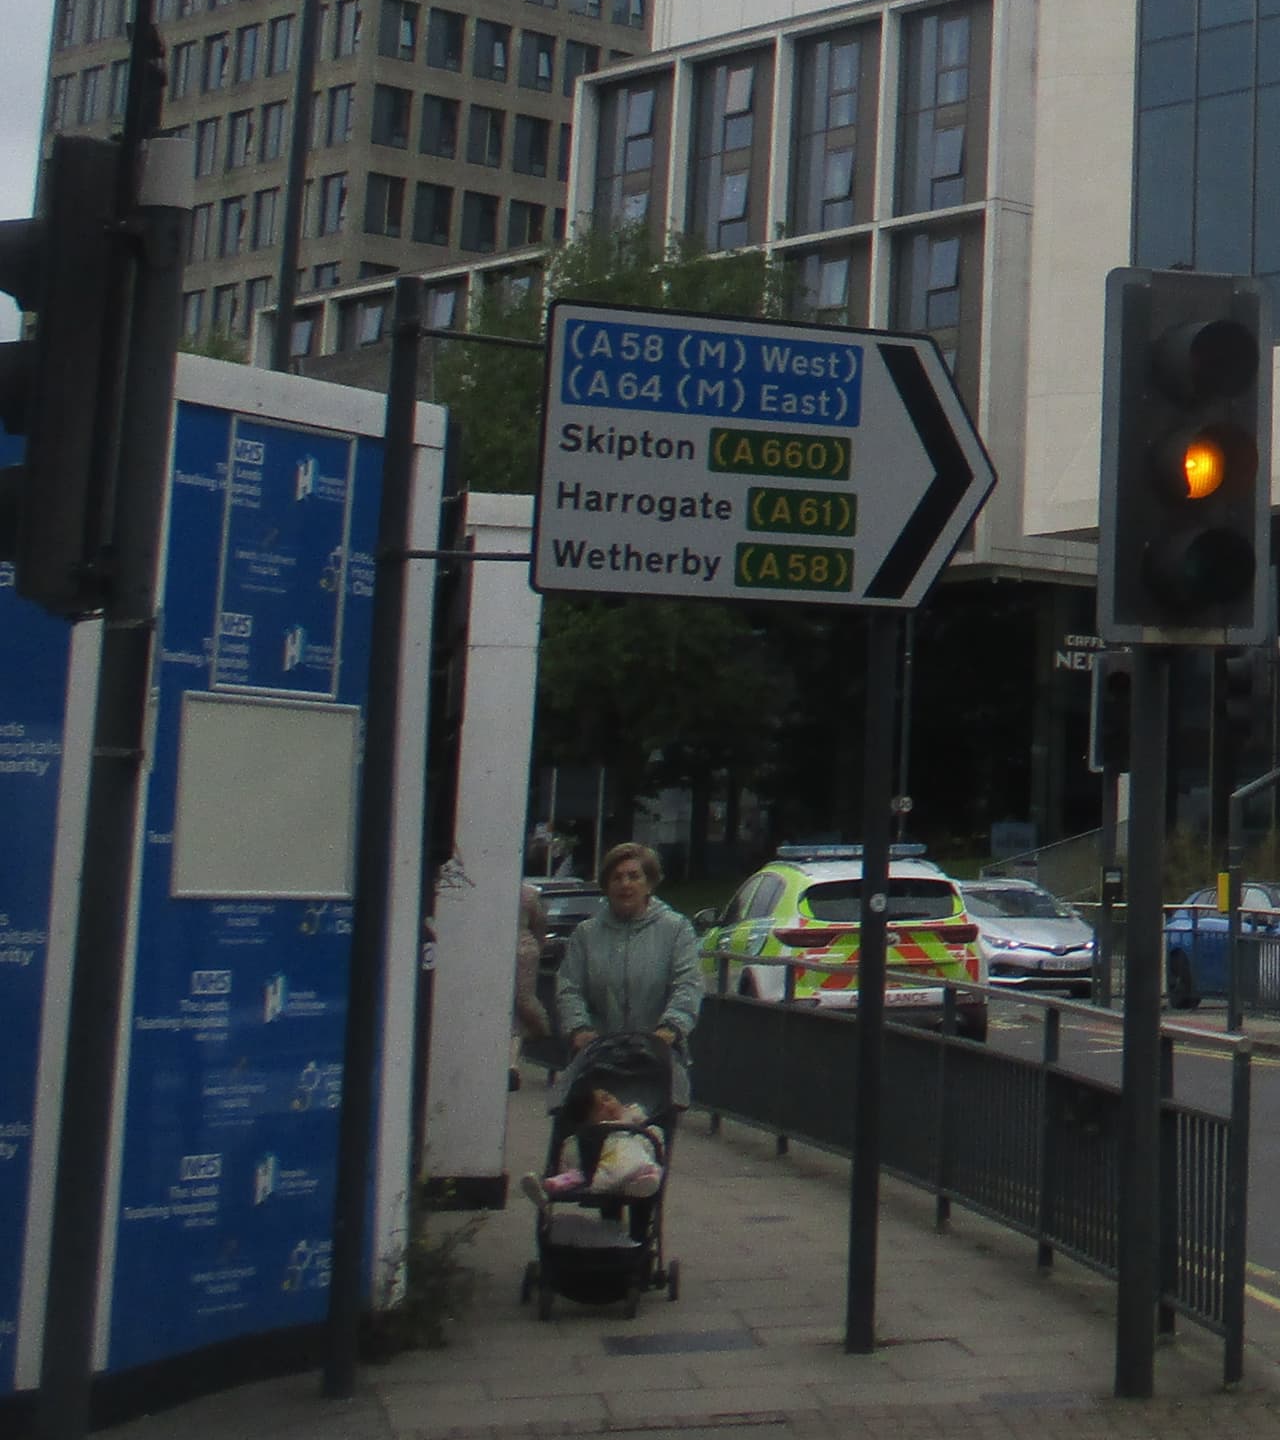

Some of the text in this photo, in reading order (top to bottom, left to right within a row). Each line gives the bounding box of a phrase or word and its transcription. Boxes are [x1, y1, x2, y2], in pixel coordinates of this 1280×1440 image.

[677, 336, 747, 371] (M)
[762, 348, 858, 382] West)
[676, 376, 746, 414] (M)
[760, 385, 848, 421] East)
[559, 423, 846, 476] Skipton (A660)
[556, 481, 850, 531] Harrogate (A61)
[553, 540, 849, 588] Wetherby (A58)
[849, 992, 929, 1005] ALANCE
